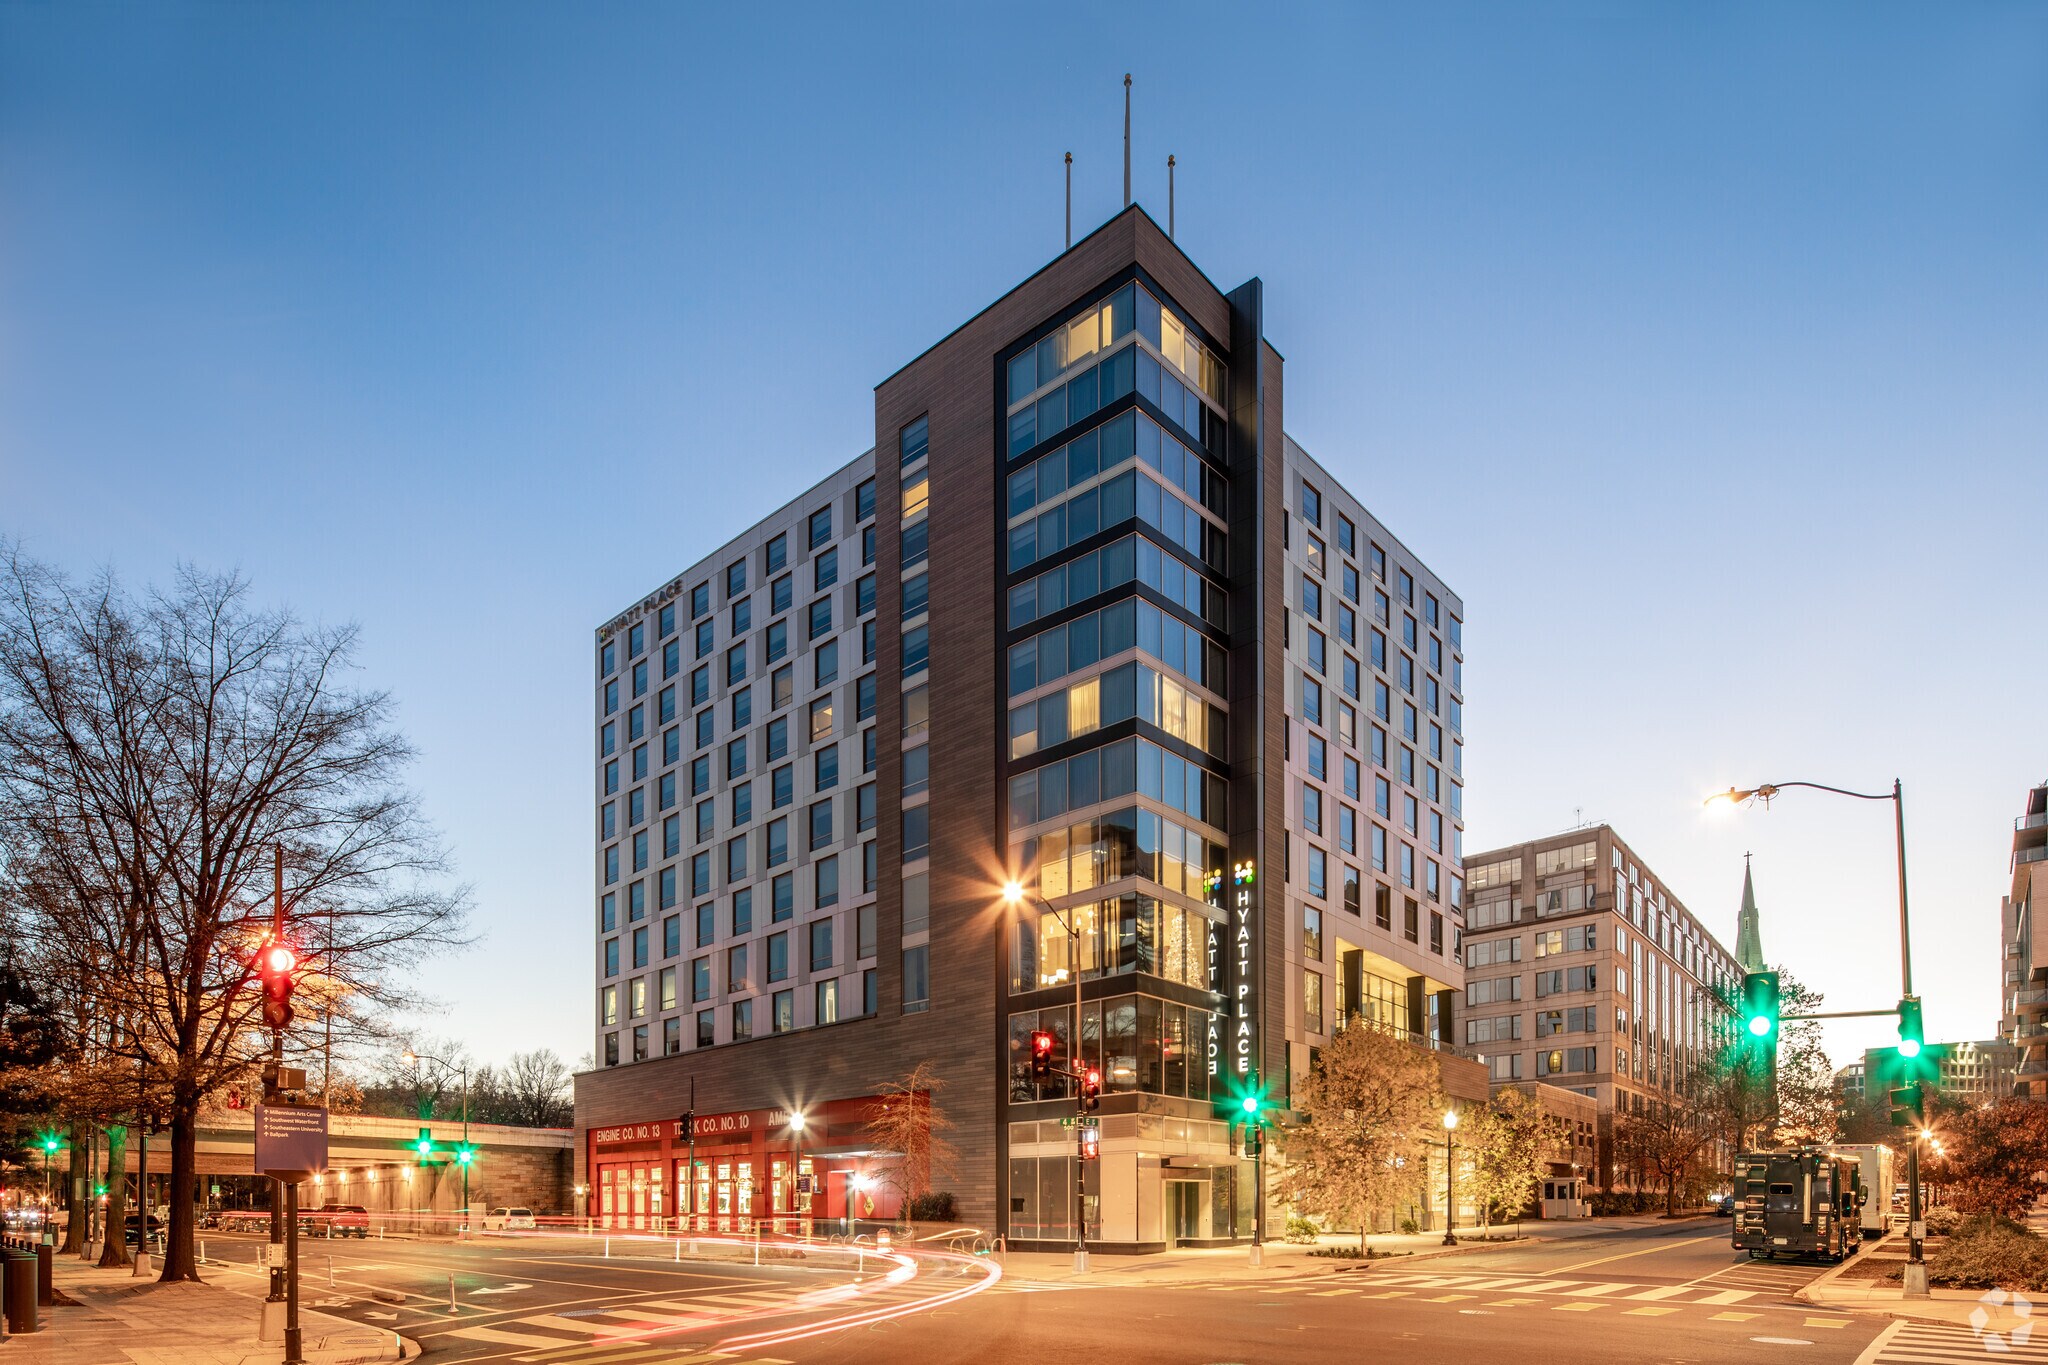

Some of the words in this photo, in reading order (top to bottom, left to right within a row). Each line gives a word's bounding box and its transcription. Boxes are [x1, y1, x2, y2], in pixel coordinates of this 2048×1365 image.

[607, 605, 641, 638] HYATT
[644, 579, 683, 614] PLACE
[1237, 890, 1250, 976] HYATT
[1237, 984, 1250, 1073] PLACE
[596, 1128, 620, 1143] ENGINE
[623, 1128, 635, 1140] CO.
[637, 1126, 649, 1139] NO.
[652, 1124, 661, 1138] 13
[703, 1117, 718, 1131] CO.
[721, 1116, 736, 1130] NO.
[739, 1114, 749, 1129] 10
